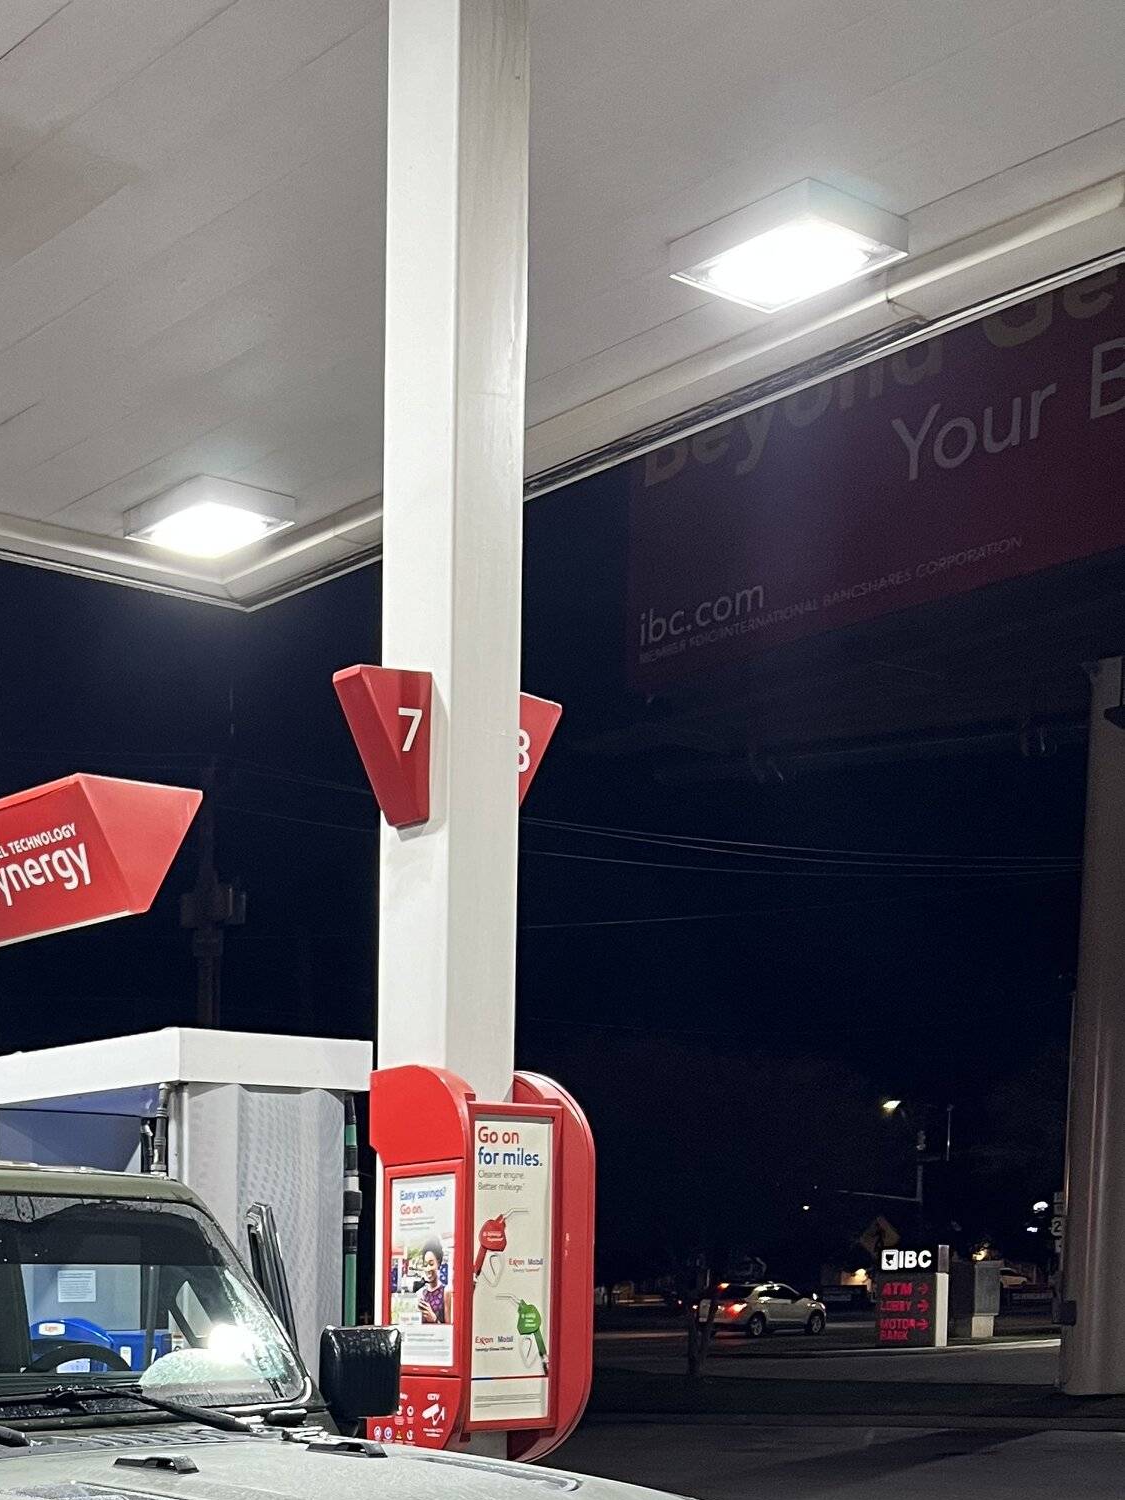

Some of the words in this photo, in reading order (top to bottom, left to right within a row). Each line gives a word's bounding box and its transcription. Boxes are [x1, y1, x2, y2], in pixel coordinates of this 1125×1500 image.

[891, 383, 1057, 481] Your
[822, 569, 911, 607] BANCSHARES
[915, 536, 1022, 578] CORPORATION
[640, 585, 764, 646] ibc.com
[398, 707, 423, 751] 7
[7, 822, 77, 855] TECHNOLOGY
[478, 1126, 498, 1144] Go
[502, 1131, 520, 1144] on
[478, 1146, 500, 1165] for
[503, 1147, 543, 1167] miles.
[400, 1189, 415, 1203] Easy
[478, 1182, 497, 1191] Better
[400, 1203, 411, 1215] Go
[898, 1250, 932, 1268] IBC
[882, 1282, 913, 1296] ATM
